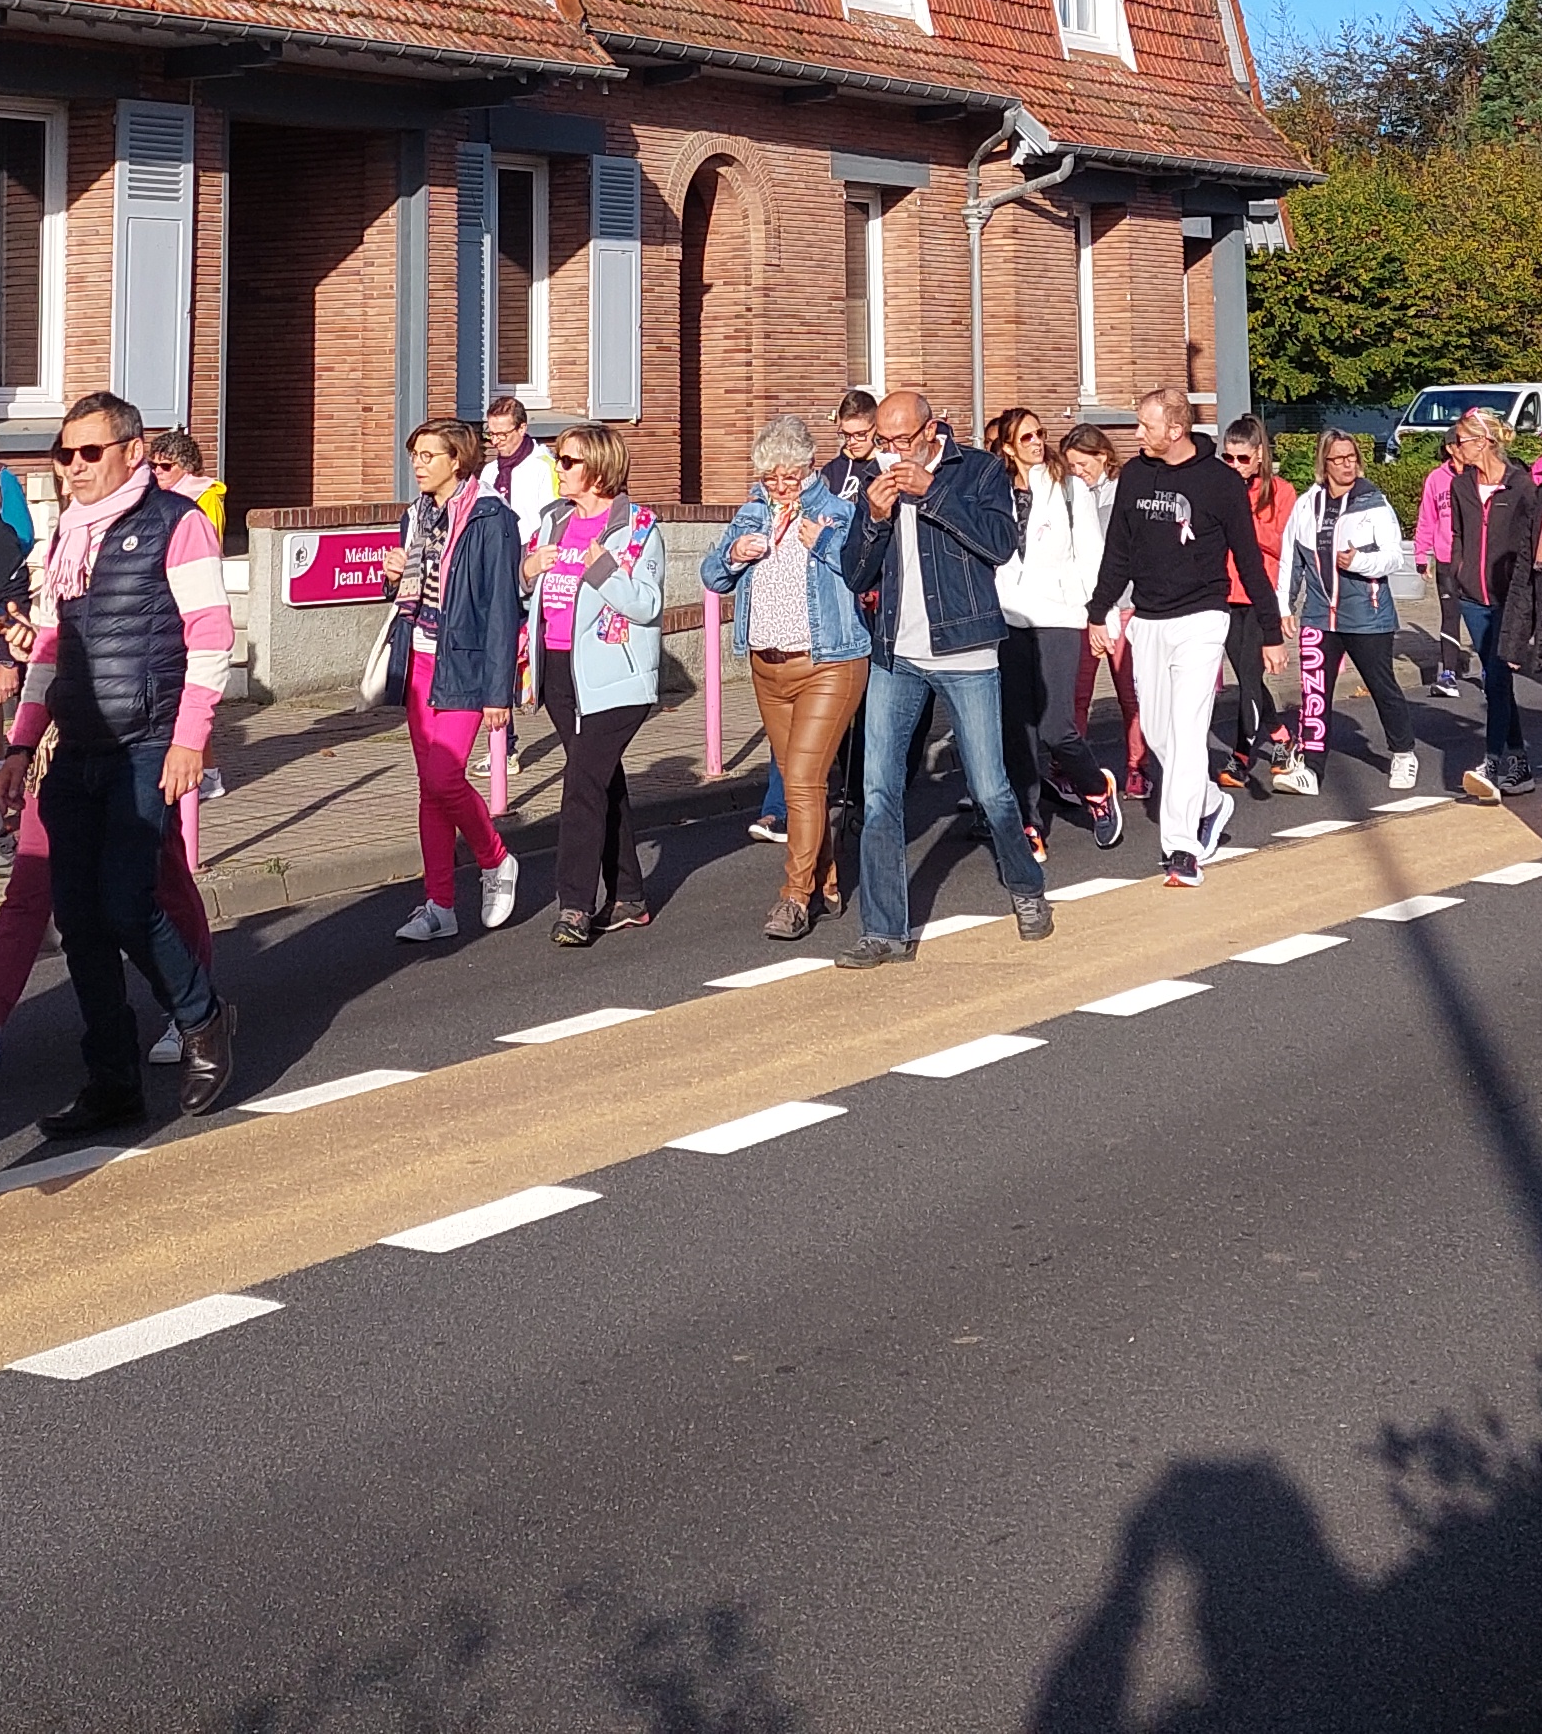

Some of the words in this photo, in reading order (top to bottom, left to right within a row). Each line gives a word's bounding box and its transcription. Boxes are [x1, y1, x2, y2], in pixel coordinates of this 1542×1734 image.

[1154, 489, 1175, 502] THE
[1136, 499, 1175, 513] NORTH
[344, 545, 393, 564] Médiath
[333, 567, 364, 590] Jean
[365, 565, 386, 584] Ar
